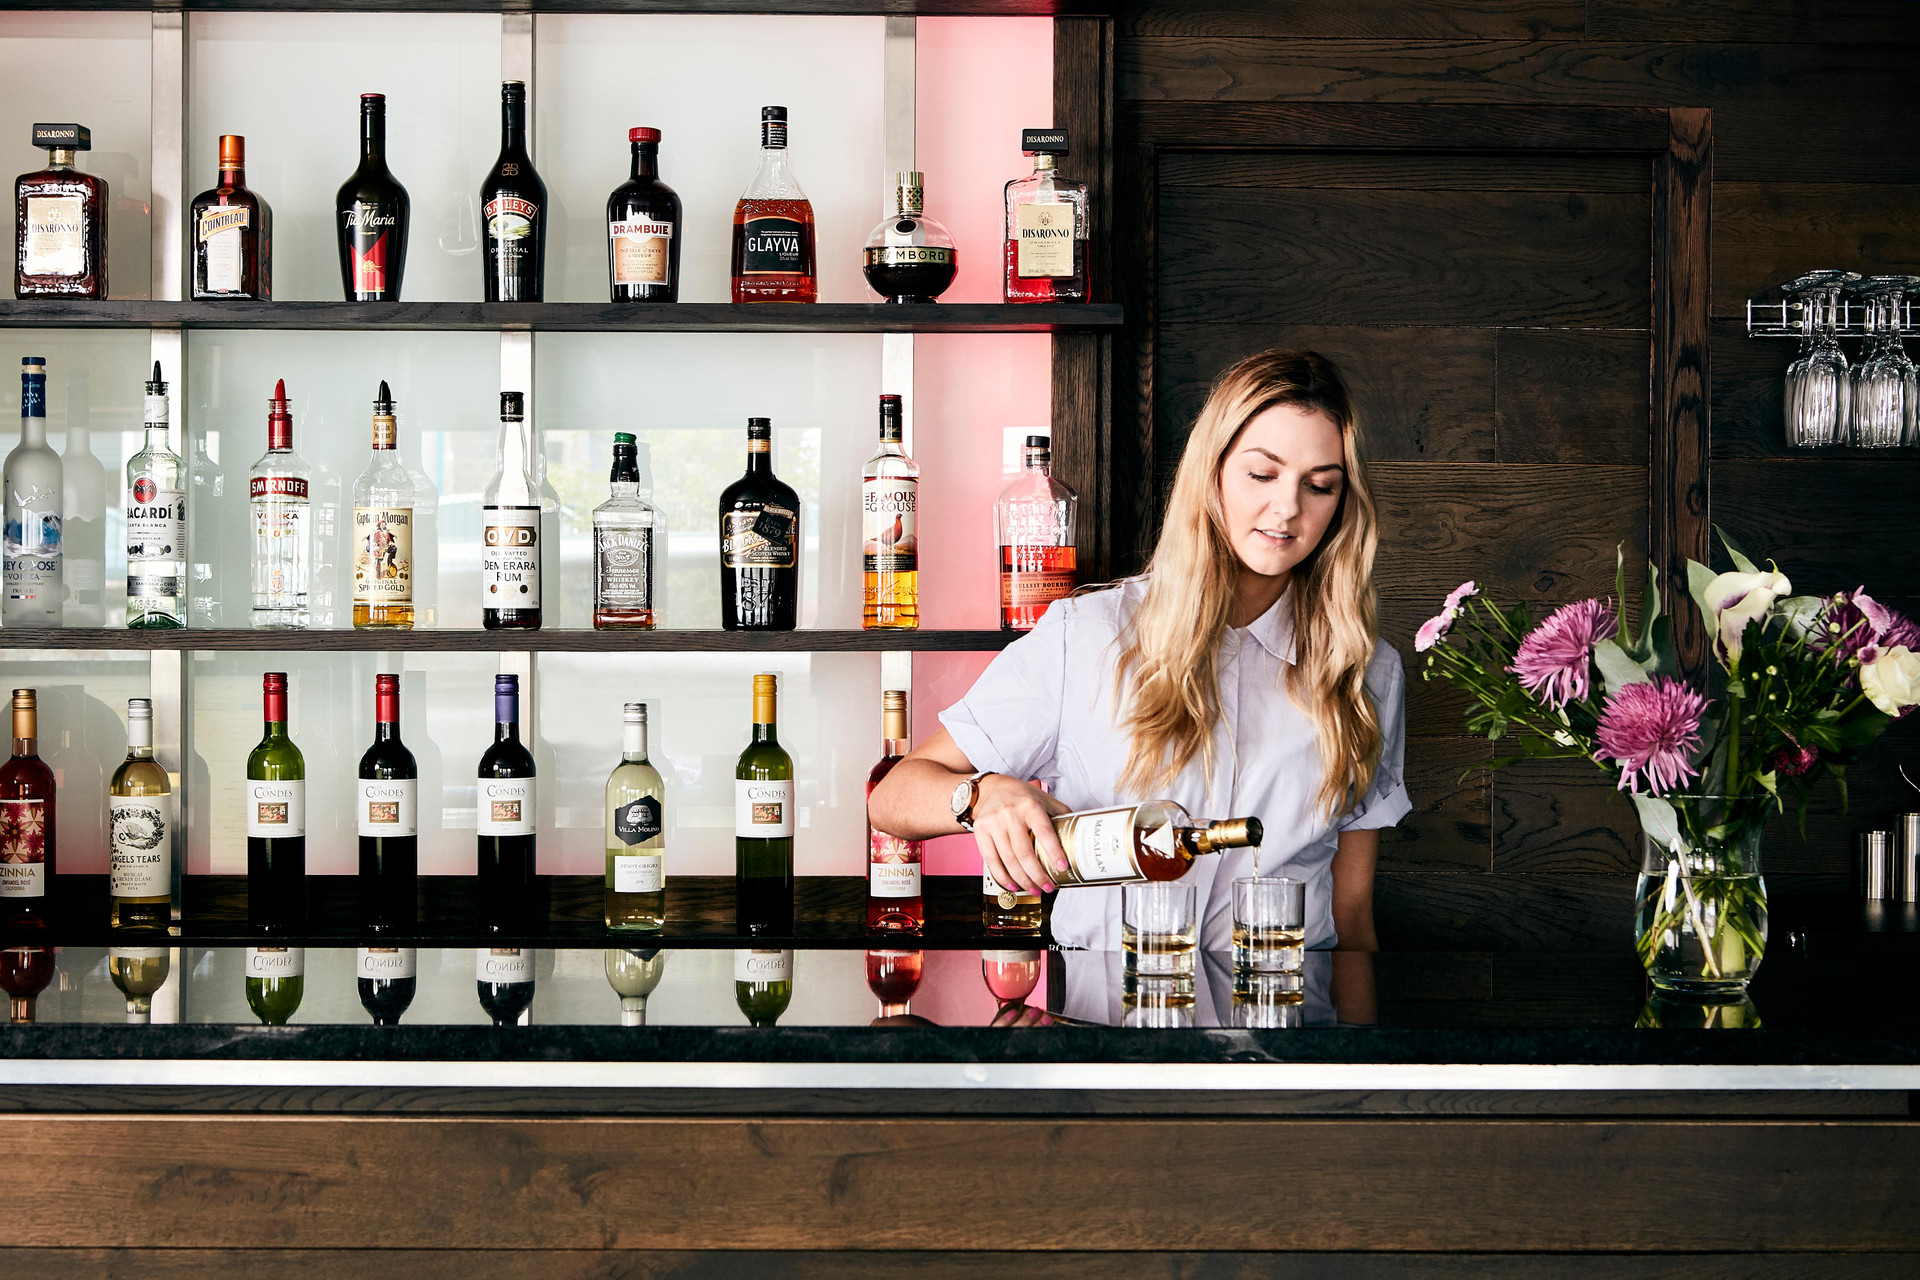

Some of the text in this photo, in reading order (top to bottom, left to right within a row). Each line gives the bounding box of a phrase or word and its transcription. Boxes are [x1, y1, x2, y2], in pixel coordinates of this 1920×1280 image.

[36, 130, 75, 138] DISARONNO
[486, 200, 534, 216] BALEYS
[202, 212, 244, 236] COINTREAU
[342, 210, 395, 229] Tia Maria
[31, 223, 80, 234] DISARONNO
[613, 224, 668, 234] DRAMBUIE
[1022, 229, 1069, 239] DISARONNO
[748, 237, 799, 252] GLAYVA
[252, 480, 305, 493] SMIRNOFF
[871, 491, 916, 502] FAMOUS
[870, 502, 916, 512] GROUSE
[380, 511, 409, 526] Morgan
[759, 521, 782, 538] 1879
[599, 537, 617, 553] JACK
[722, 532, 756, 553] BLACK
[3, 561, 56, 570] REY GOSE
[485, 561, 536, 570] DEMERARA
[497, 572, 522, 581] RUM
[359, 584, 405, 592] SPIED GOLD
[254, 787, 293, 799] CONDES
[365, 786, 404, 798] CONDES
[487, 785, 525, 797] CONDES
[748, 788, 786, 799] CONDES
[1094, 819, 1107, 873] MACALLAN
[111, 855, 161, 864] ANGELS TEARS
[0, 868, 36, 877] ZINNIA
[878, 868, 915, 878] ZINNIA
